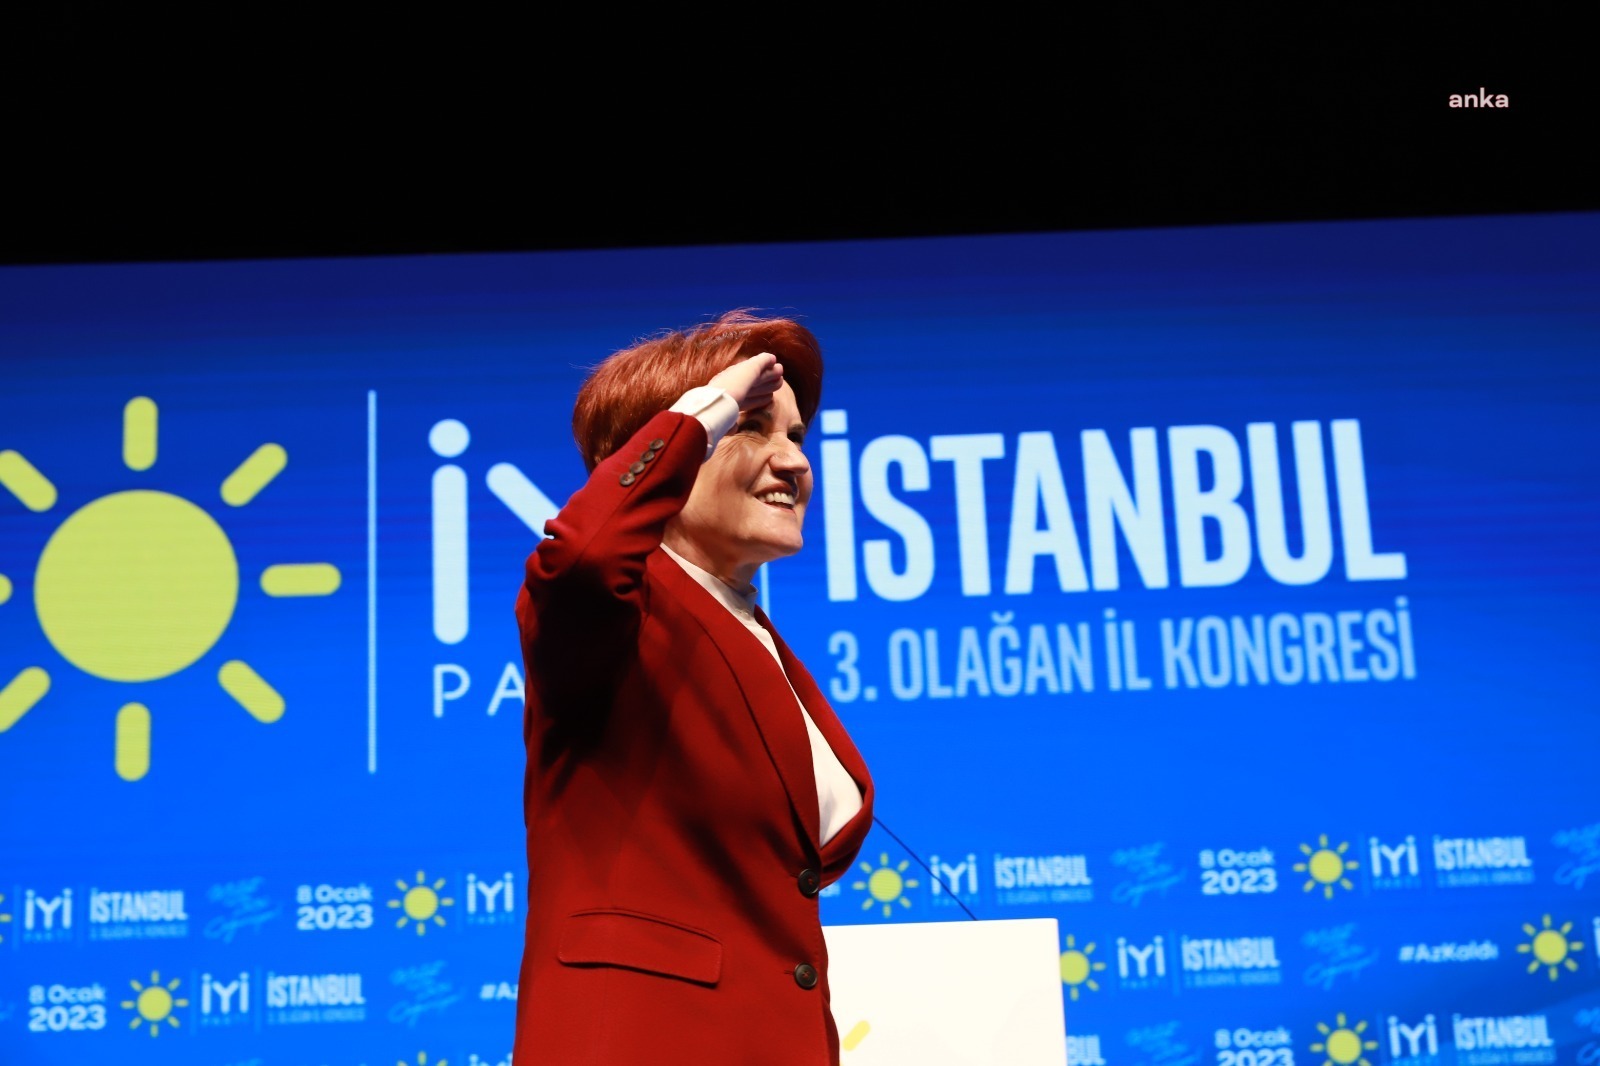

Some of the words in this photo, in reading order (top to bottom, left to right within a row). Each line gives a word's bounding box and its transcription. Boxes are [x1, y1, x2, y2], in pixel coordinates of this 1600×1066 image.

[820, 409, 1408, 601] İSTANBUL
[828, 631, 877, 702] 3.
[888, 610, 1094, 700] OLAĞAN
[1103, 608, 1152, 692] İL
[1160, 595, 1416, 688] KONGRESİ
[1199, 849, 1216, 869] 8
[1217, 848, 1274, 868] Ocak
[1433, 837, 1532, 870] İSTANBUL
[994, 854, 1092, 889] İSTANBUL
[1201, 868, 1278, 895] 2023
[90, 888, 188, 923] İSTANBUL
[297, 885, 313, 904] 8
[314, 883, 373, 903] Ocak
[297, 904, 374, 930] 2023
[1181, 936, 1280, 971] İSTANBUL
[29, 985, 45, 1005] 8
[47, 984, 105, 1004] Ocak
[267, 972, 366, 1008] İSTANBUL
[28, 1004, 106, 1032] 2023
[1454, 1016, 1554, 1050] İSTANBUL
[1215, 1029, 1232, 1049] 8
[1232, 1027, 1291, 1048] Ocak
